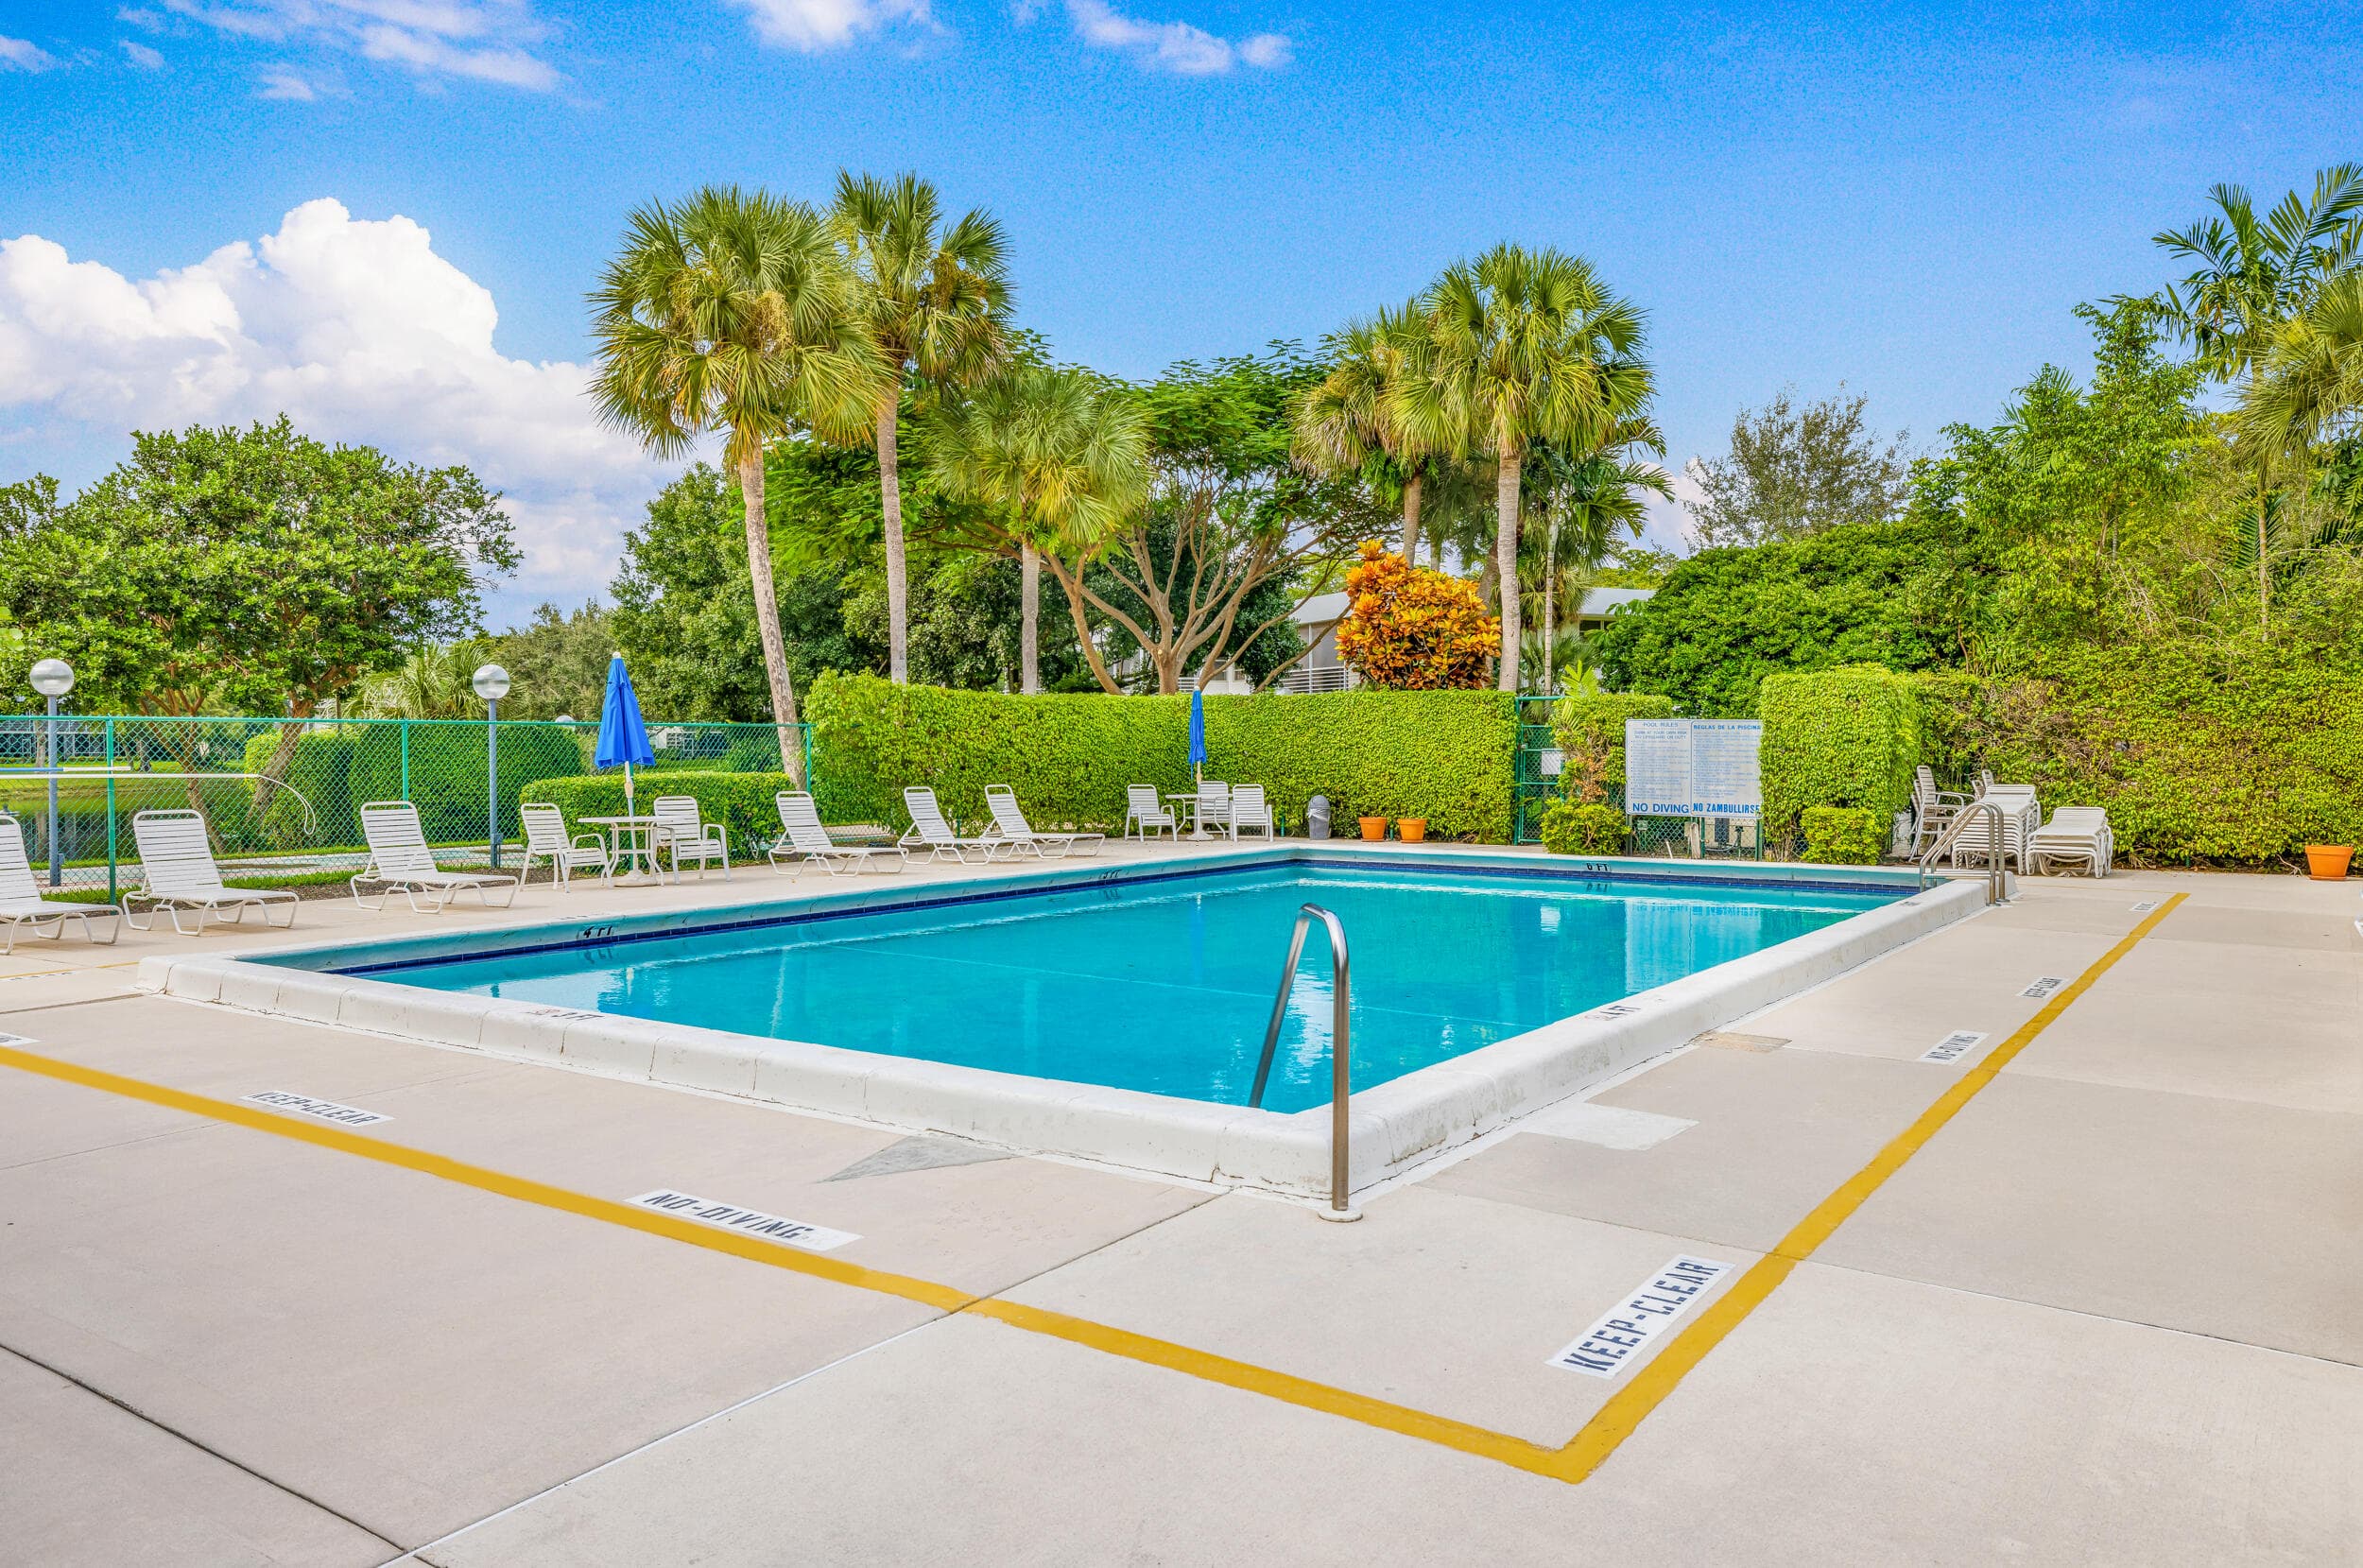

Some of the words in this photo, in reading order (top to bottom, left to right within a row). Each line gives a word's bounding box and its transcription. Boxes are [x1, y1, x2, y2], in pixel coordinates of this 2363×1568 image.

[1632, 803, 1648, 812] NO
[1652, 803, 1689, 813] DIVING
[1693, 802, 1703, 812] NO
[1706, 803, 1760, 814] ZAMBULLIRSE
[583, 925, 595, 938] 4
[247, 1091, 381, 1125] KEEP-CLEAR
[642, 1193, 815, 1240] NO-DIVING
[1562, 1261, 1720, 1372] KEEP-CLEAR
